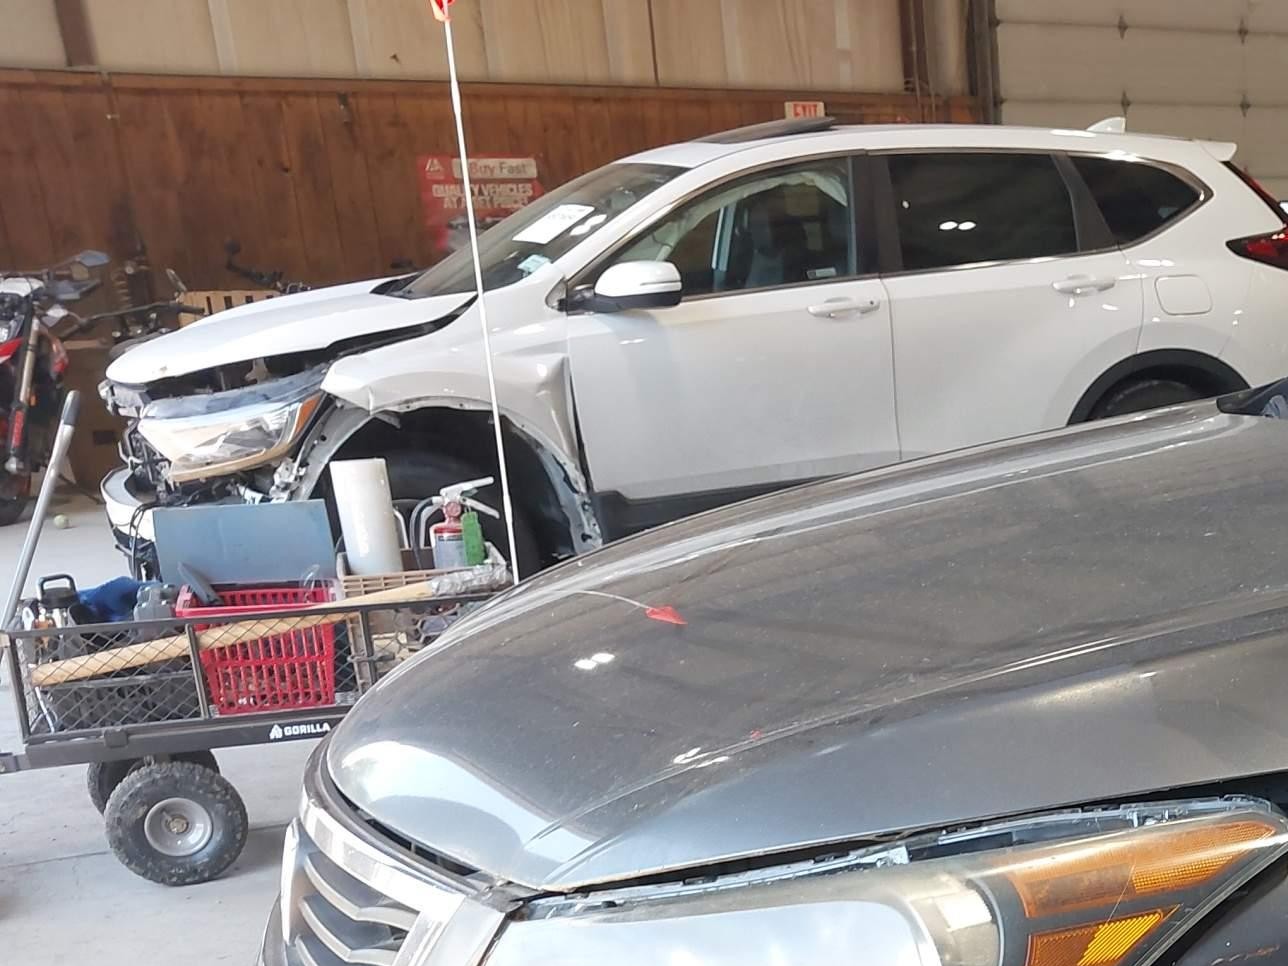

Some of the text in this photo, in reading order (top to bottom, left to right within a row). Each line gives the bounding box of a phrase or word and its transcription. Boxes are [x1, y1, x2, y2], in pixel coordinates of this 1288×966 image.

[499, 161, 528, 174] Fast
[481, 183, 533, 197] VEHICLES
[283, 722, 331, 736] GORILLA
